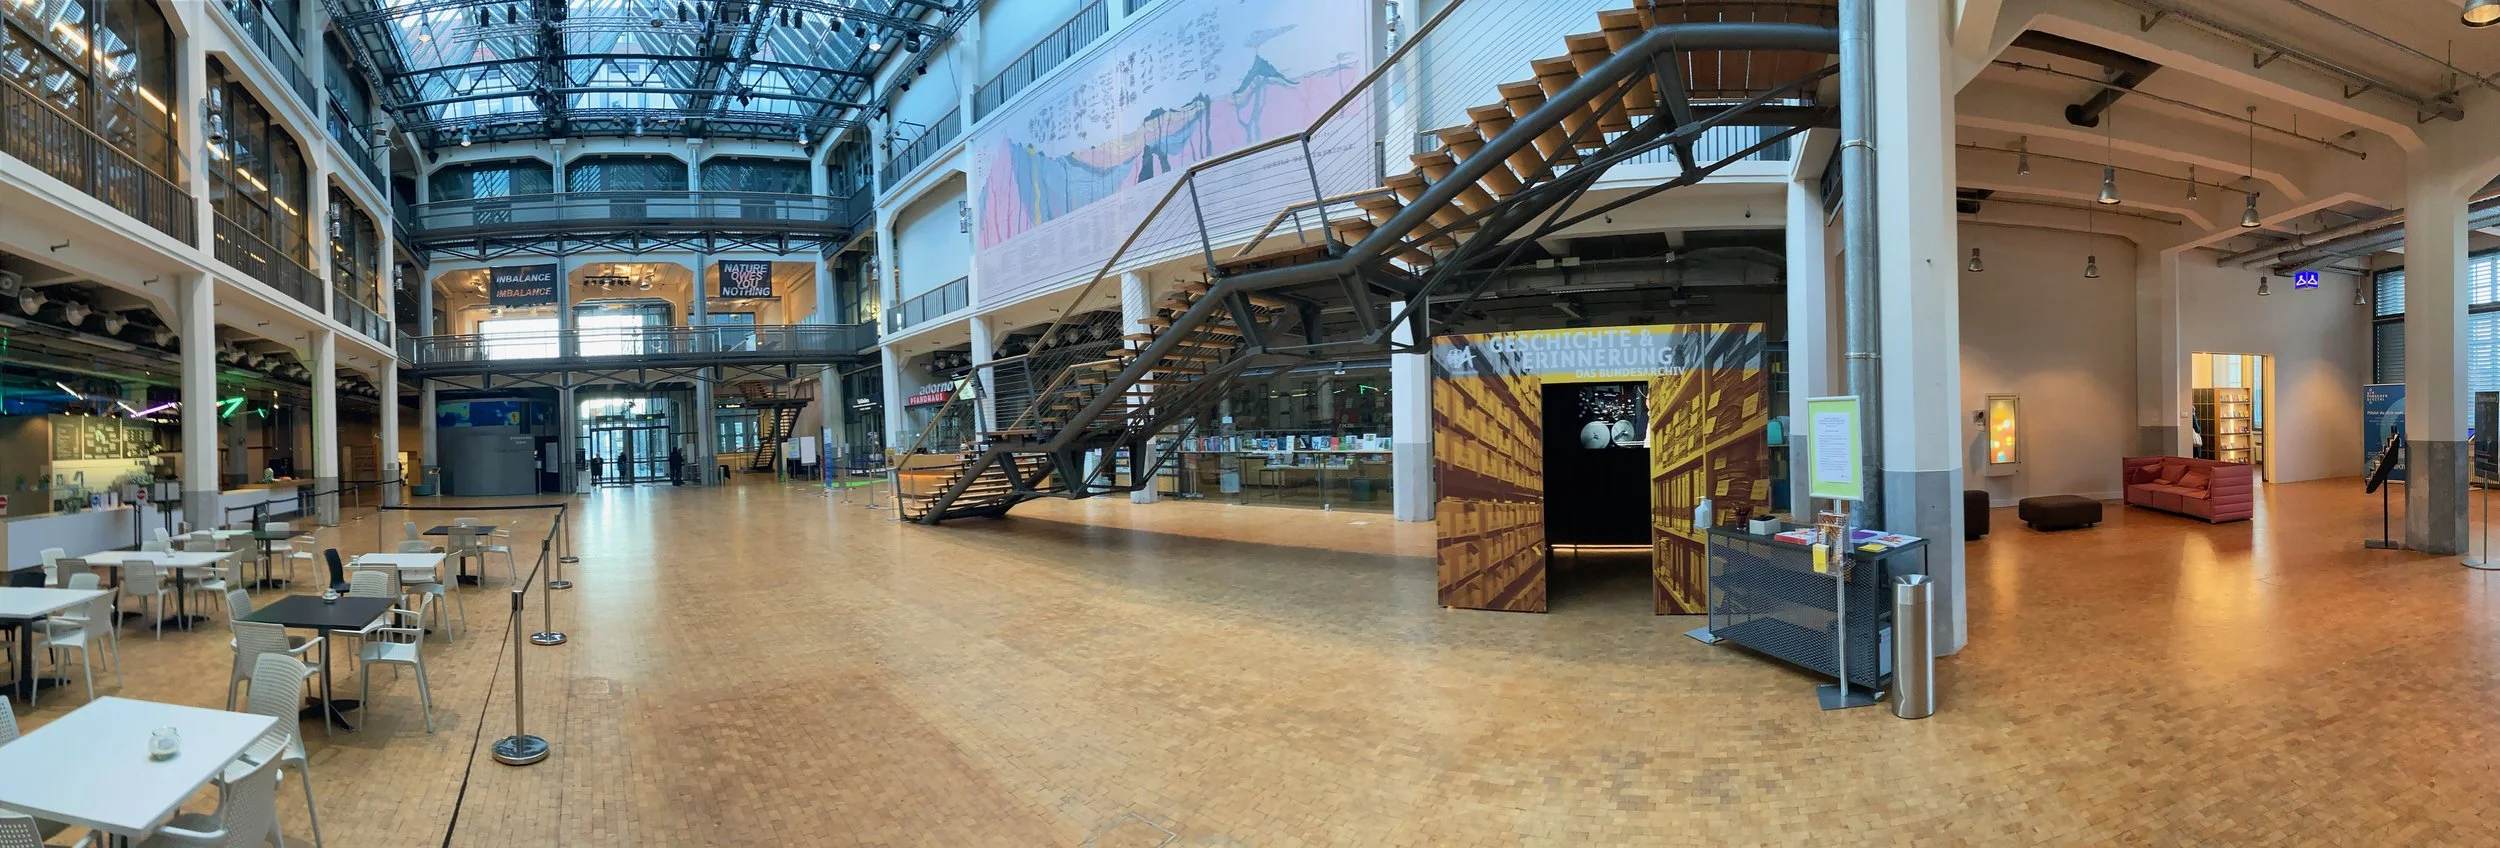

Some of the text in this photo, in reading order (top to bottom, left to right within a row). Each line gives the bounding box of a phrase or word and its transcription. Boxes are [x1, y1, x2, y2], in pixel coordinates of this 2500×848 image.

[724, 263, 767, 273] NATURE
[496, 272, 552, 283] INBALANCE
[731, 271, 763, 281] OWES
[736, 279, 759, 290] YOU
[496, 287, 552, 298] IMBALANCE
[722, 286, 770, 296] NOTHING
[1490, 328, 1654, 353] GESCHICHTE &
[1522, 346, 1672, 371] ERINNERUNG
[1575, 366, 1686, 379] DAS BUNDESARCHIV
[919, 381, 954, 395] adorno
